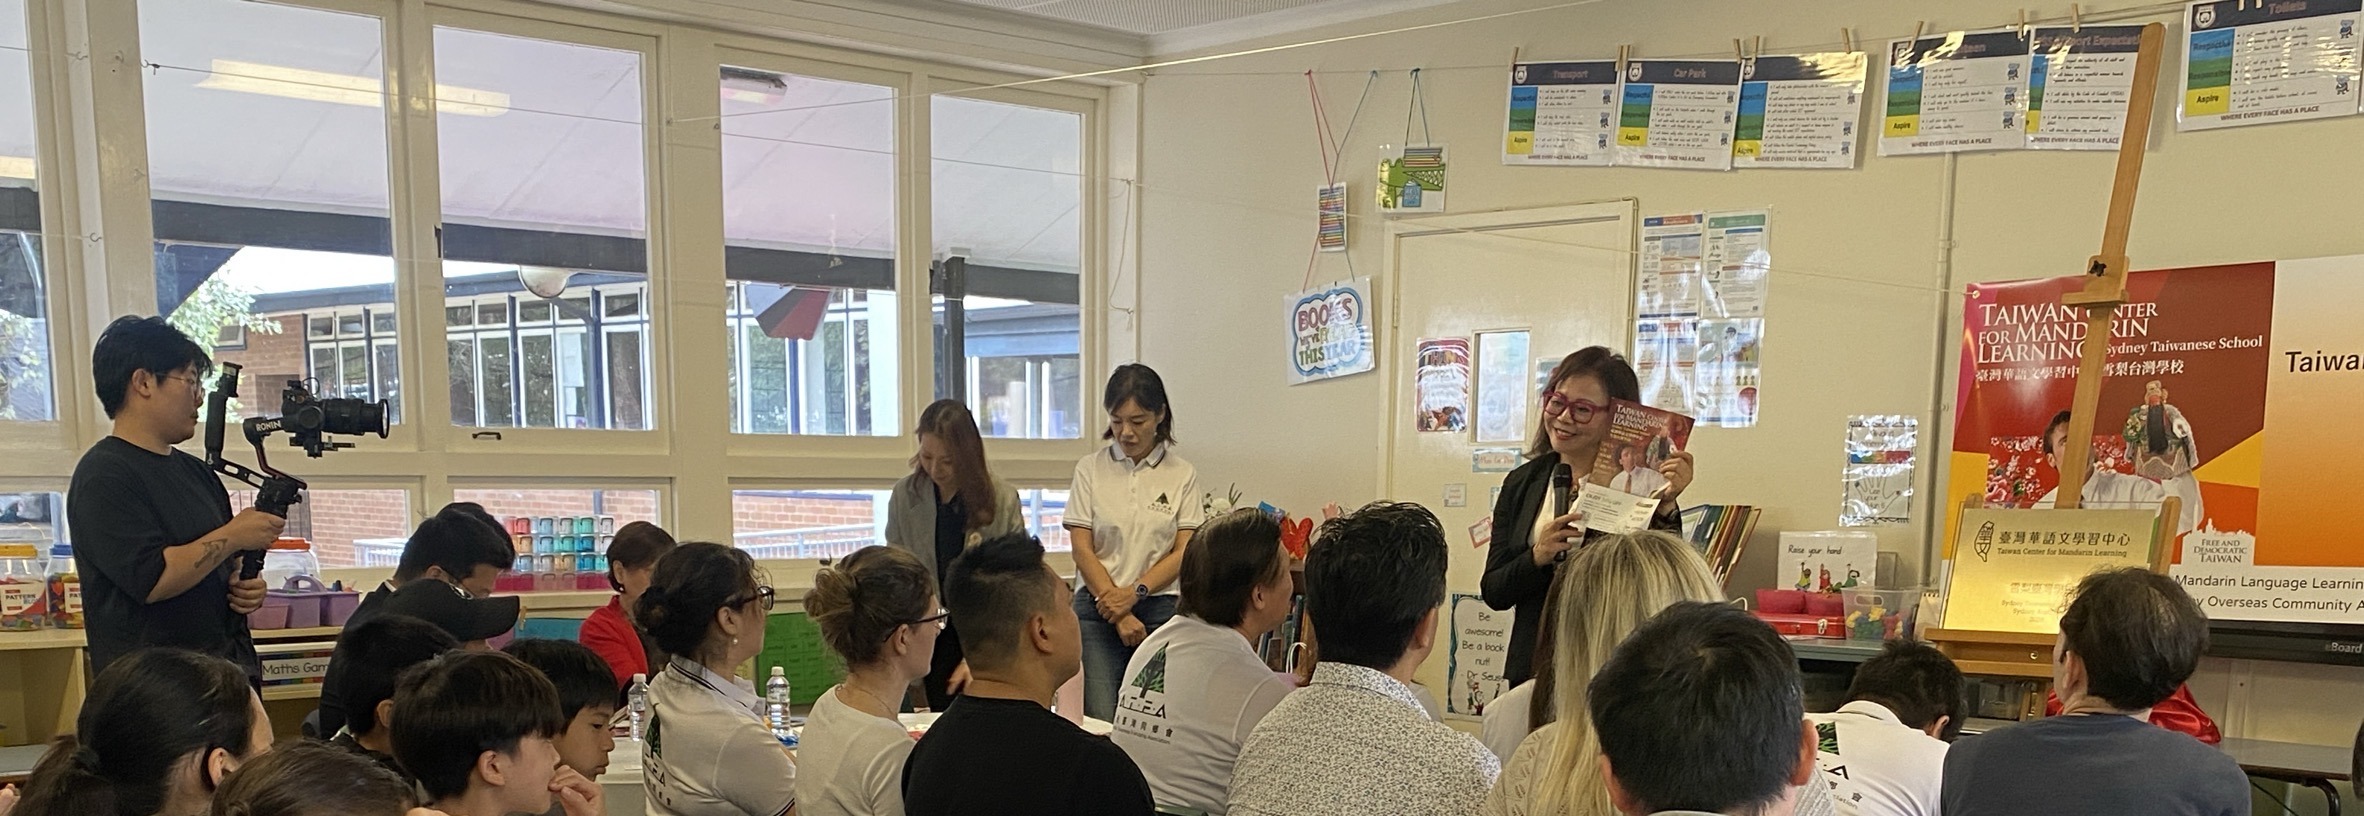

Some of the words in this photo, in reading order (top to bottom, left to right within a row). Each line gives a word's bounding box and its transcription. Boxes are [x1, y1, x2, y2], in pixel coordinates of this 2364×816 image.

[2268, 1, 2306, 15] Toilets
[1553, 70, 1588, 80] Transport
[1674, 68, 1687, 78] Car
[1688, 68, 1707, 78] Park
[2196, 94, 2219, 105] Aspire
[2221, 113, 2242, 121] WHERE
[2264, 110, 2279, 118] FACE
[1979, 302, 2078, 327] TAIWAN
[1978, 331, 2011, 345] FOR
[2015, 318, 2150, 343] MANDRIN
[2105, 344, 2148, 357] Sydney
[2150, 340, 2216, 352] Taiwanese
[2218, 335, 2263, 348] School
[1299, 347, 1324, 366] THIS
[1324, 340, 1356, 360] YEAR
[2285, 350, 2364, 373] Taiwa
[256, 420, 282, 432] RONIN
[1999, 531, 2131, 546] 臺灣華語文學習中心
[2201, 538, 2221, 546] FREE
[2221, 539, 2240, 547] AND
[1788, 544, 1805, 555] Raise
[1808, 548, 1822, 557] your
[1827, 546, 1842, 555] hand
[1997, 548, 2021, 556] Taiwan
[2047, 548, 2057, 556] for
[2058, 548, 2093, 556] Mandarin
[2094, 549, 2127, 558] Learning
[2193, 546, 2247, 554] DEMOCRATIC
[2199, 553, 2242, 563] TAIWAN
[2174, 575, 2236, 587] Mandarin
[2241, 576, 2307, 590] Language
[2312, 577, 2364, 589] Learnin
[2207, 596, 2268, 608] Overseas
[2272, 598, 2352, 613] Community
[1478, 612, 1490, 622] Be
[1464, 628, 1504, 637] awesome!
[1462, 640, 1474, 650] Be
[1485, 641, 1505, 652] book
[1475, 657, 1490, 665] nut!
[263, 664, 300, 675] Maths
[1466, 670, 1479, 680] Dr
